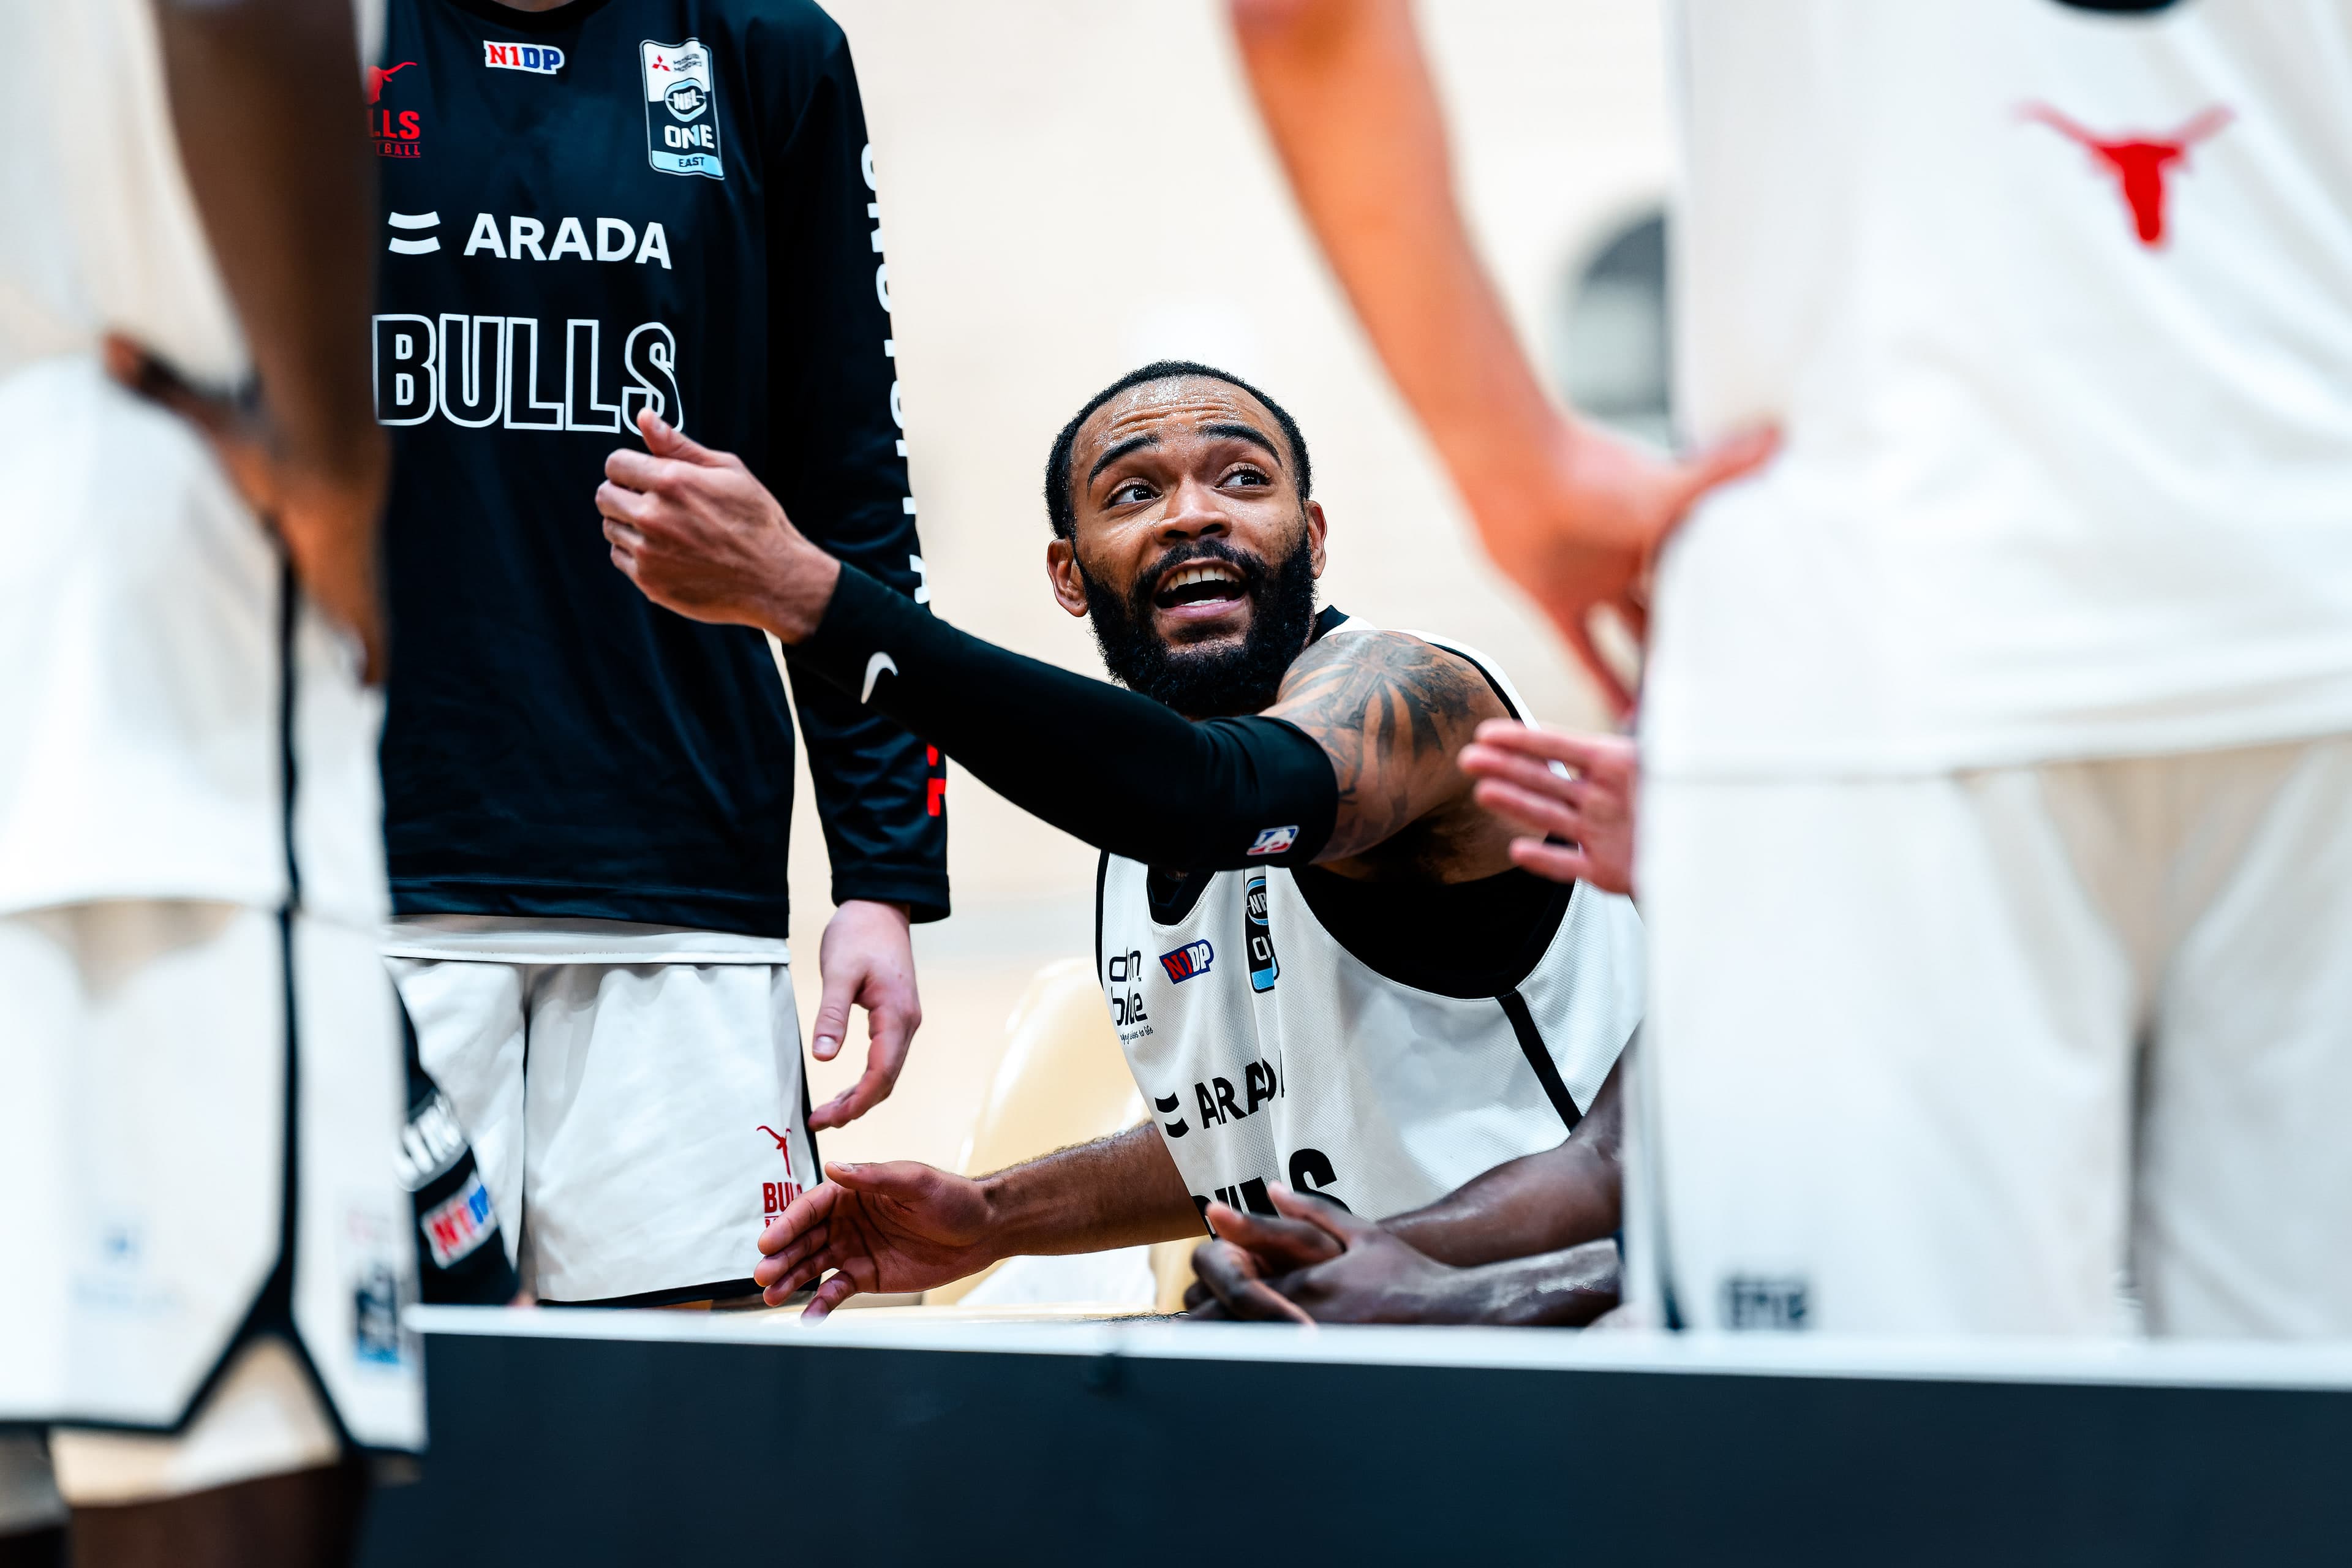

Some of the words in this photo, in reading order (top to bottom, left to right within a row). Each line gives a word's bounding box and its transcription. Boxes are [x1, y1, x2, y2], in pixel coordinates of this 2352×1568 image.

[488, 44, 560, 70] N1DP
[673, 89, 700, 110] NBL
[368, 108, 421, 140] LLS
[664, 124, 715, 149] ONE
[679, 157, 705, 167] EAST
[464, 213, 673, 270] ARADA
[372, 313, 684, 437] BULLS
[1163, 943, 1211, 980] N1DP
